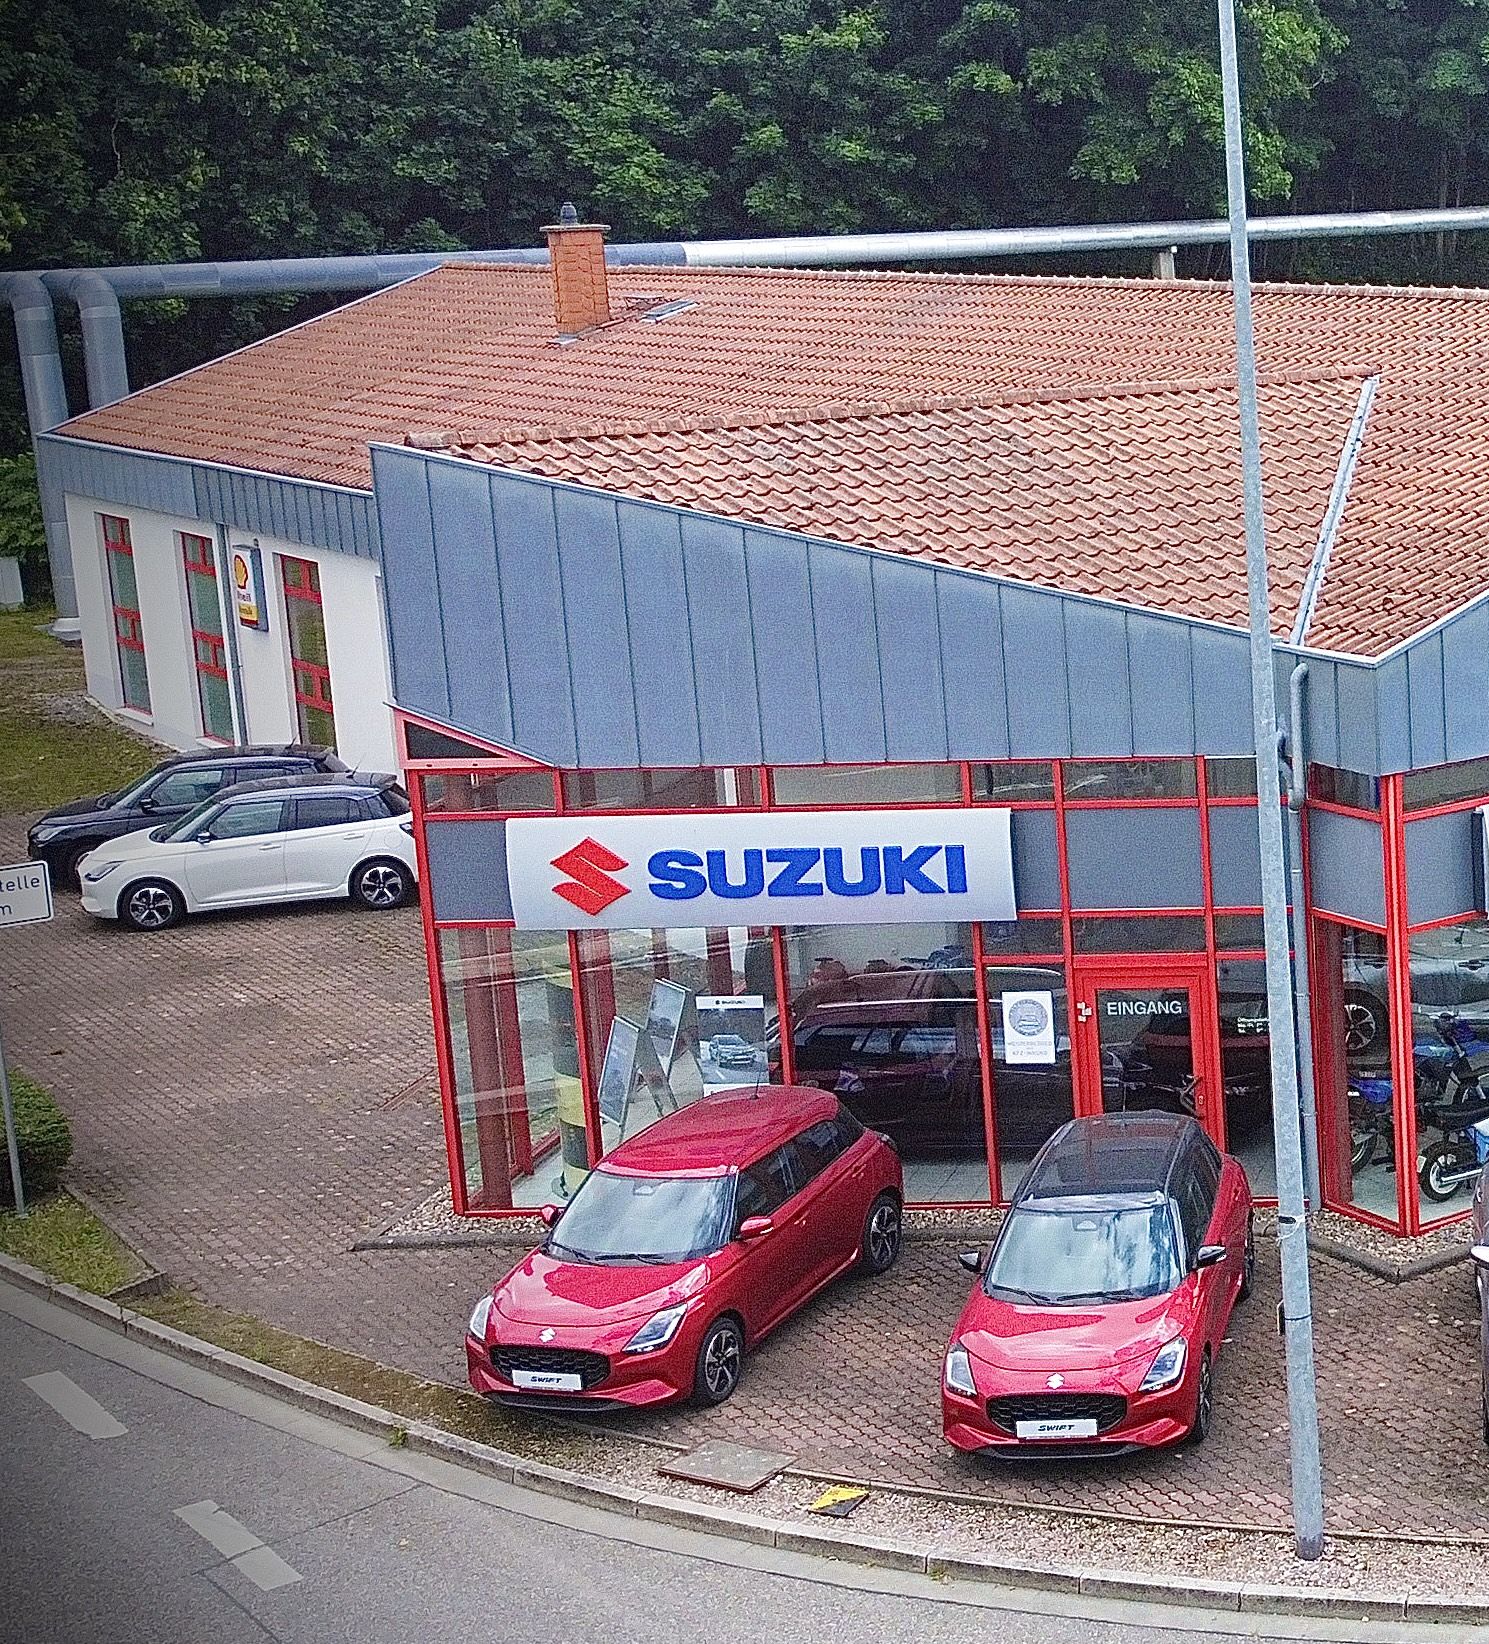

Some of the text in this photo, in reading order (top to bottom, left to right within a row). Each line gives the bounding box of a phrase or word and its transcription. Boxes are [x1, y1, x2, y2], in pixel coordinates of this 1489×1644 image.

[648, 844, 967, 900] SUZUKI
[1107, 1000, 1182, 1016] EINGANG
[530, 1375, 563, 1384] SWIFT
[1037, 1424, 1076, 1432] SWIFT
